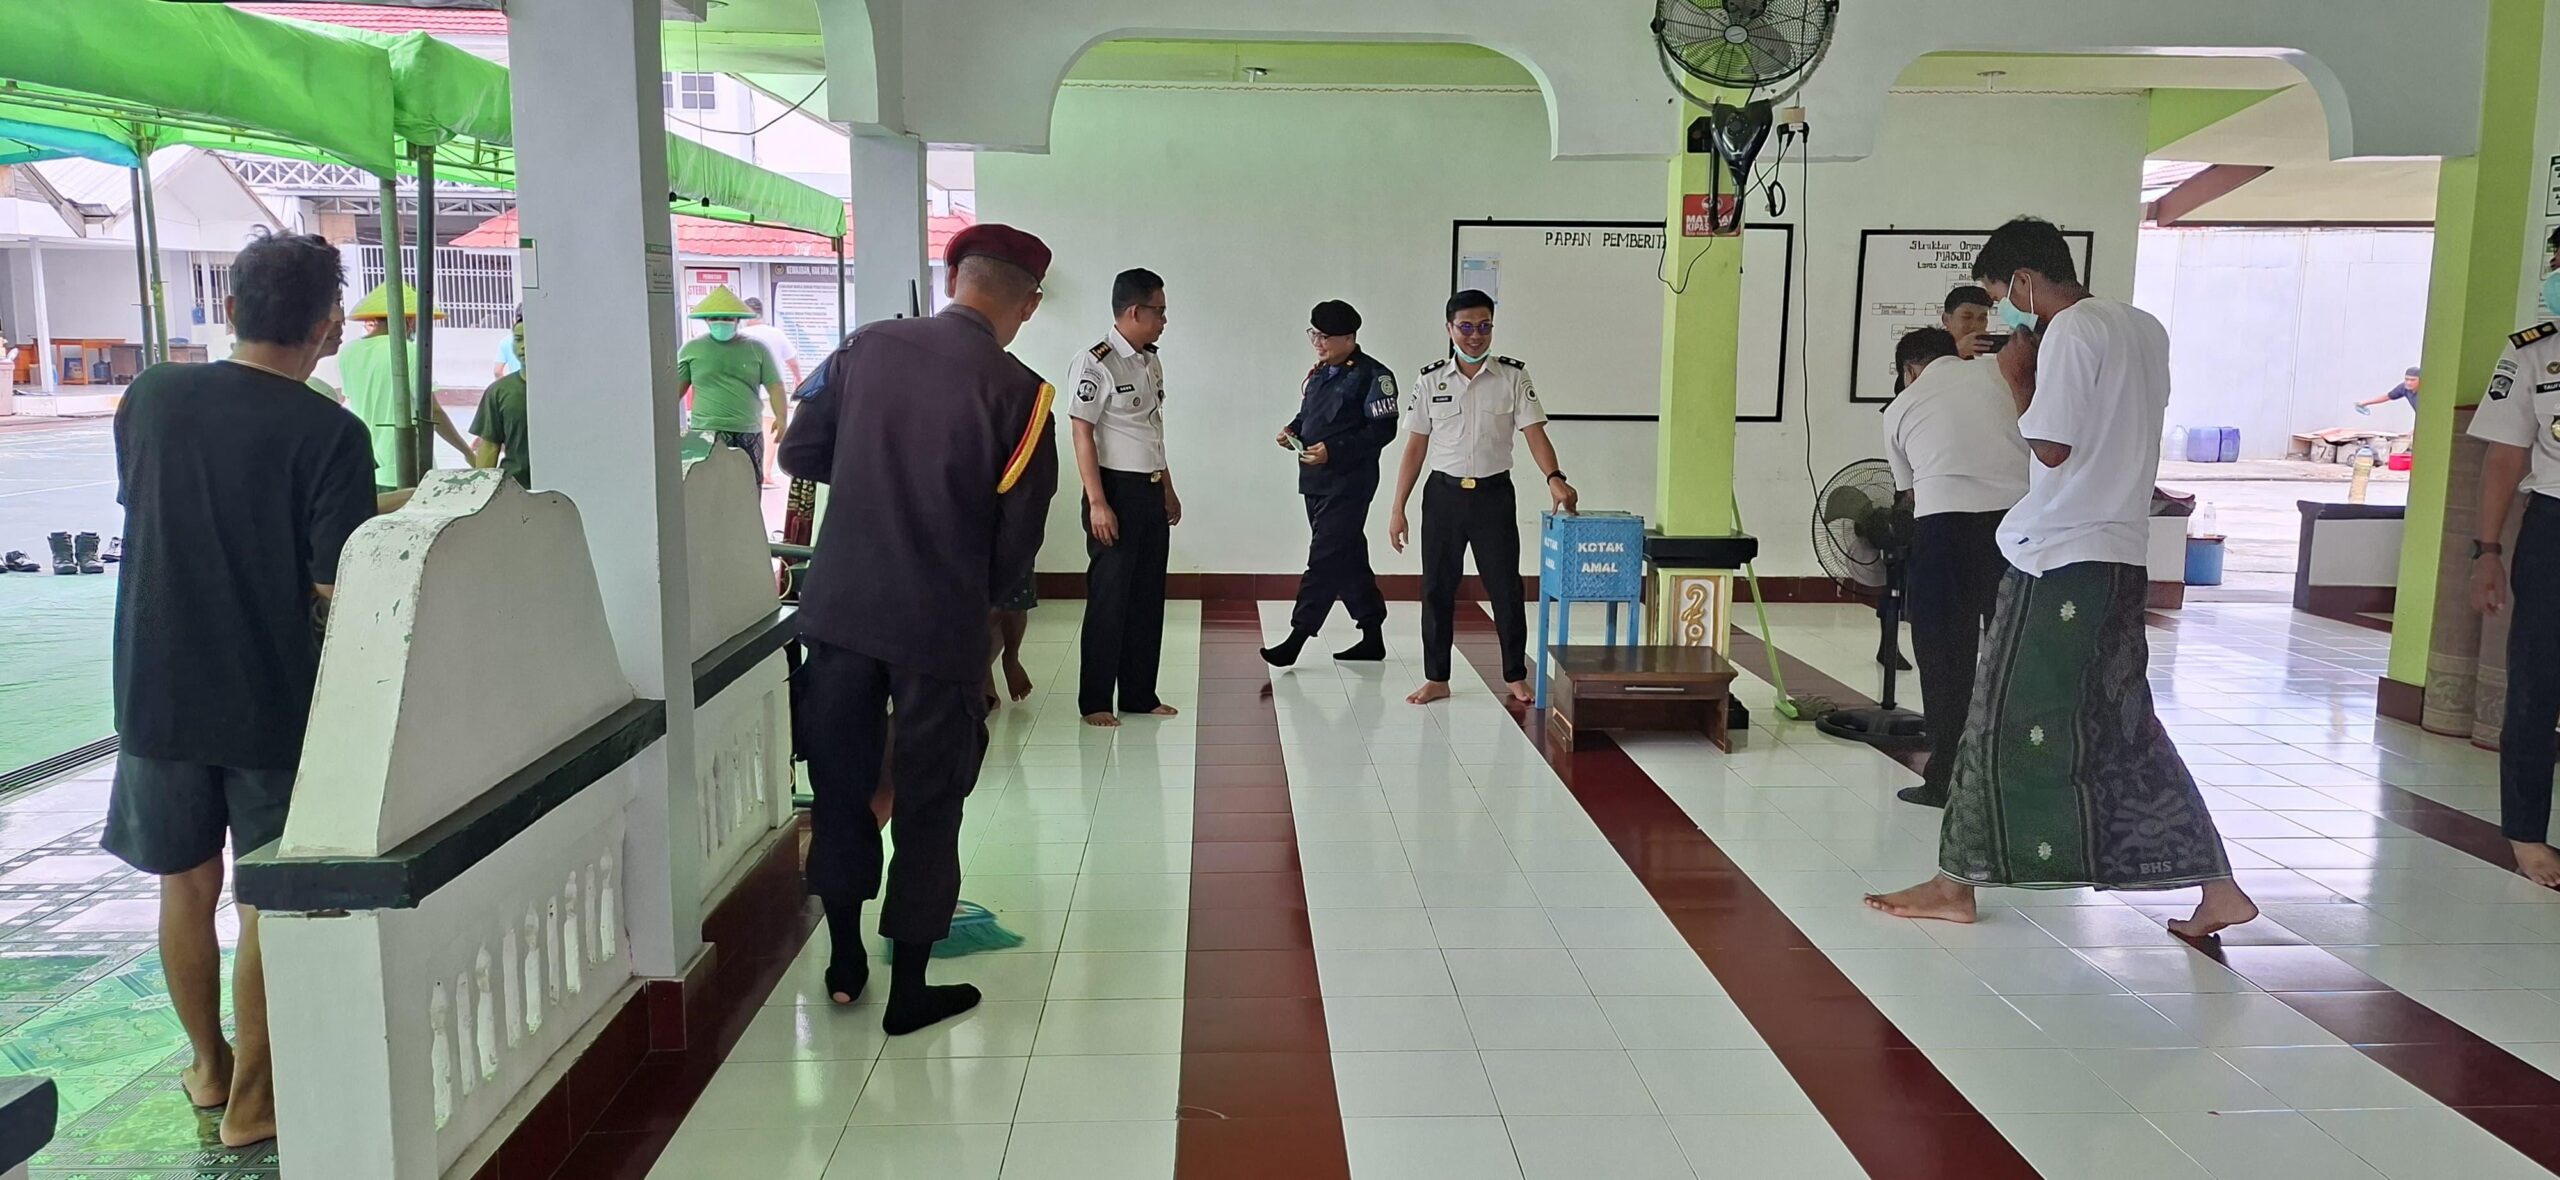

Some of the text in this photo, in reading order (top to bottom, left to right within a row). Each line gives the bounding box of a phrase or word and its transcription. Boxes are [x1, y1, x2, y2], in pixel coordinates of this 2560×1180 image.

[1545, 231, 1591, 246] PAPAN
[1909, 240, 1951, 250] Struktur
[1935, 251, 1971, 261] MASJID
[1577, 542, 1624, 553] KOTAK
[1581, 562, 1618, 573] AMAL
[2140, 860, 2172, 874] BHS
